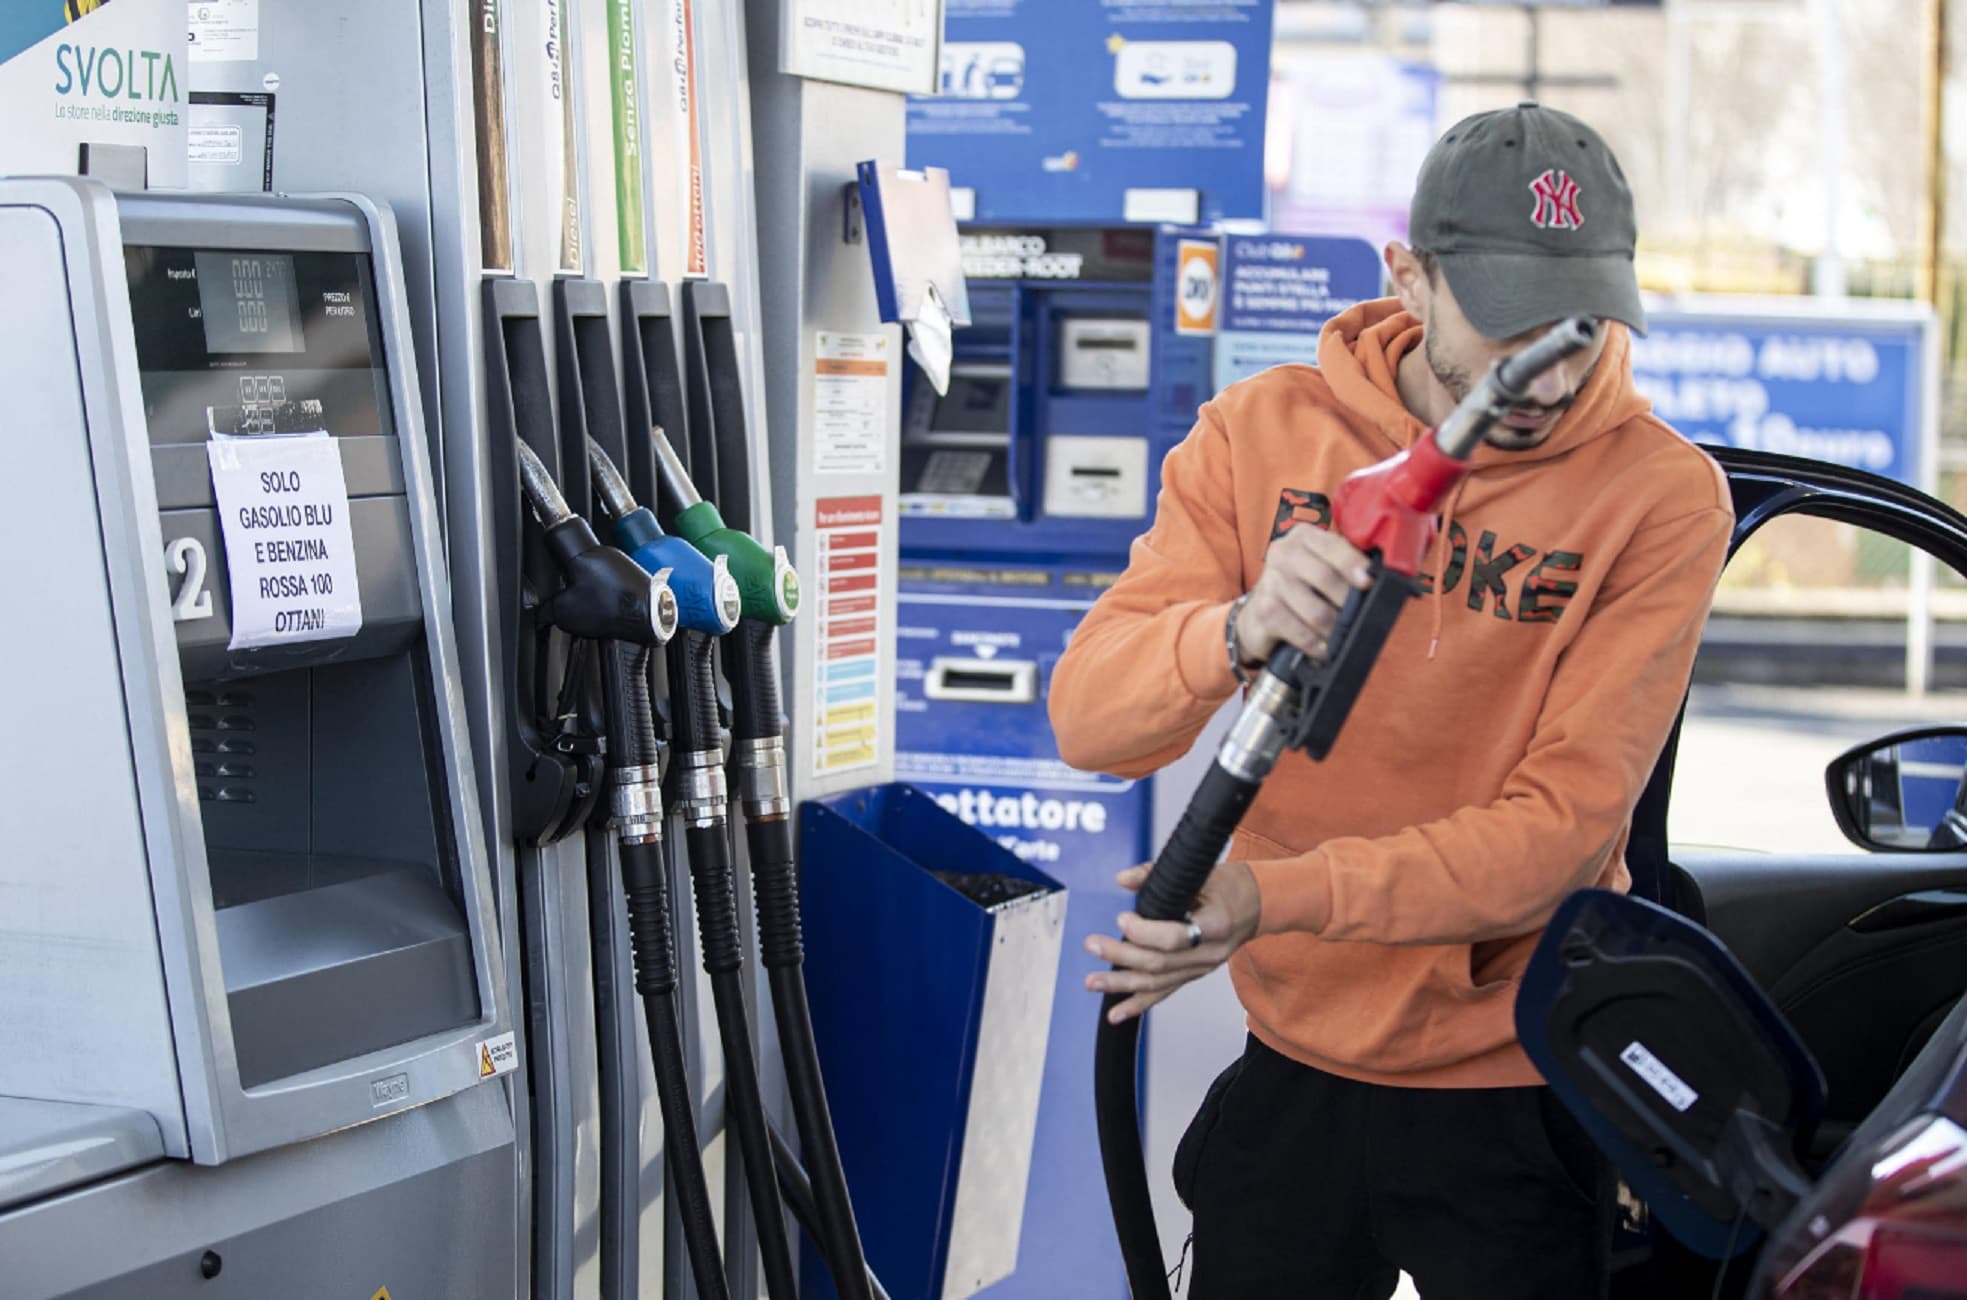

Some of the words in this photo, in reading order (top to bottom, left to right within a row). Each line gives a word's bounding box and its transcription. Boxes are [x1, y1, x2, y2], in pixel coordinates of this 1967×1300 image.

[483, 0, 496, 34] Di
[621, 0, 634, 71] Plom
[55, 44, 179, 103] SVOLTA
[67, 103, 90, 120] store
[91, 104, 111, 121] nella
[112, 105, 151, 124] direzione
[152, 107, 179, 128] giusta
[623, 79, 638, 156] Senza
[566, 197, 580, 266] Diesel
[260, 471, 301, 493] SOLO
[239, 506, 302, 529] GASOLIO
[304, 504, 333, 526] BLU
[254, 542, 265, 563] E
[268, 539, 329, 563] BENZINA
[164, 536, 214, 621] 2
[259, 574, 308, 599] ROSSA
[311, 573, 333, 595] 100
[275, 609, 325, 632] OTTANI
[934, 789, 1107, 834] ettatore
